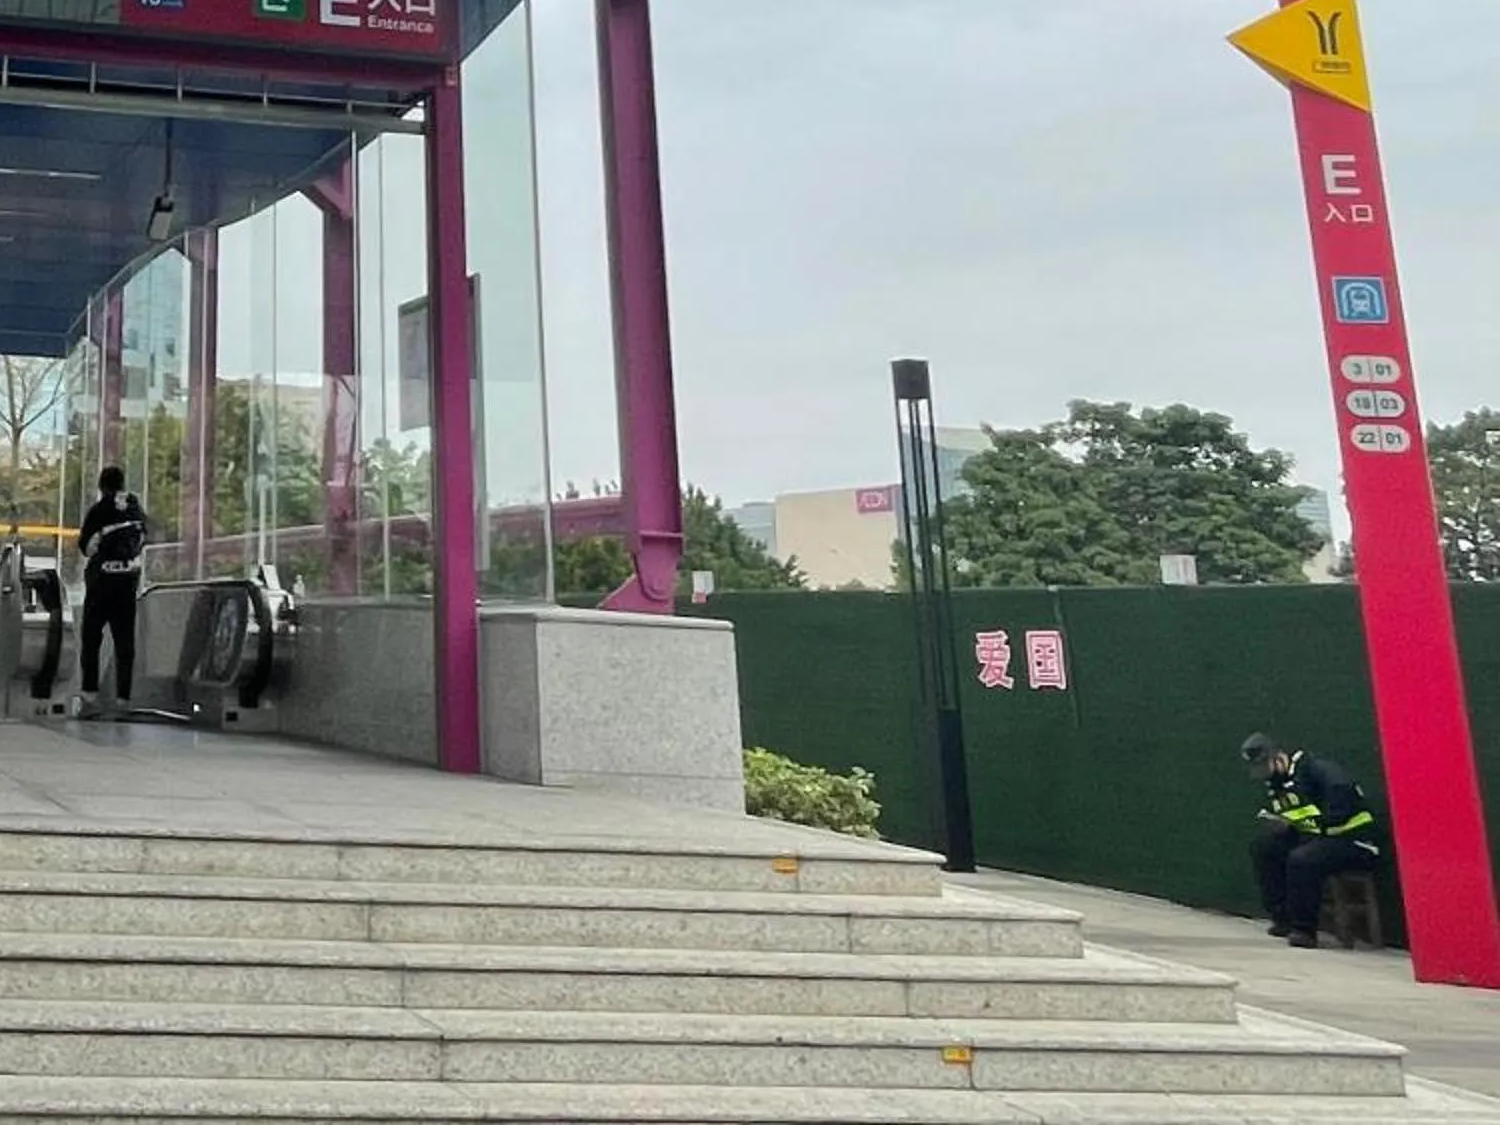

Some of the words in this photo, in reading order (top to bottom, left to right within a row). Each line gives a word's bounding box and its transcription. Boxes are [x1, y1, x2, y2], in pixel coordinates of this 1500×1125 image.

[367, 14, 435, 34] Entrance
[1321, 154, 1363, 195] E
[1323, 201, 1375, 224] 入口
[1375, 362, 1392, 376] 01
[1380, 397, 1399, 410] 03
[1357, 431, 1376, 444] 22
[1385, 431, 1402, 445] 01
[974, 629, 1067, 690] 爱国
